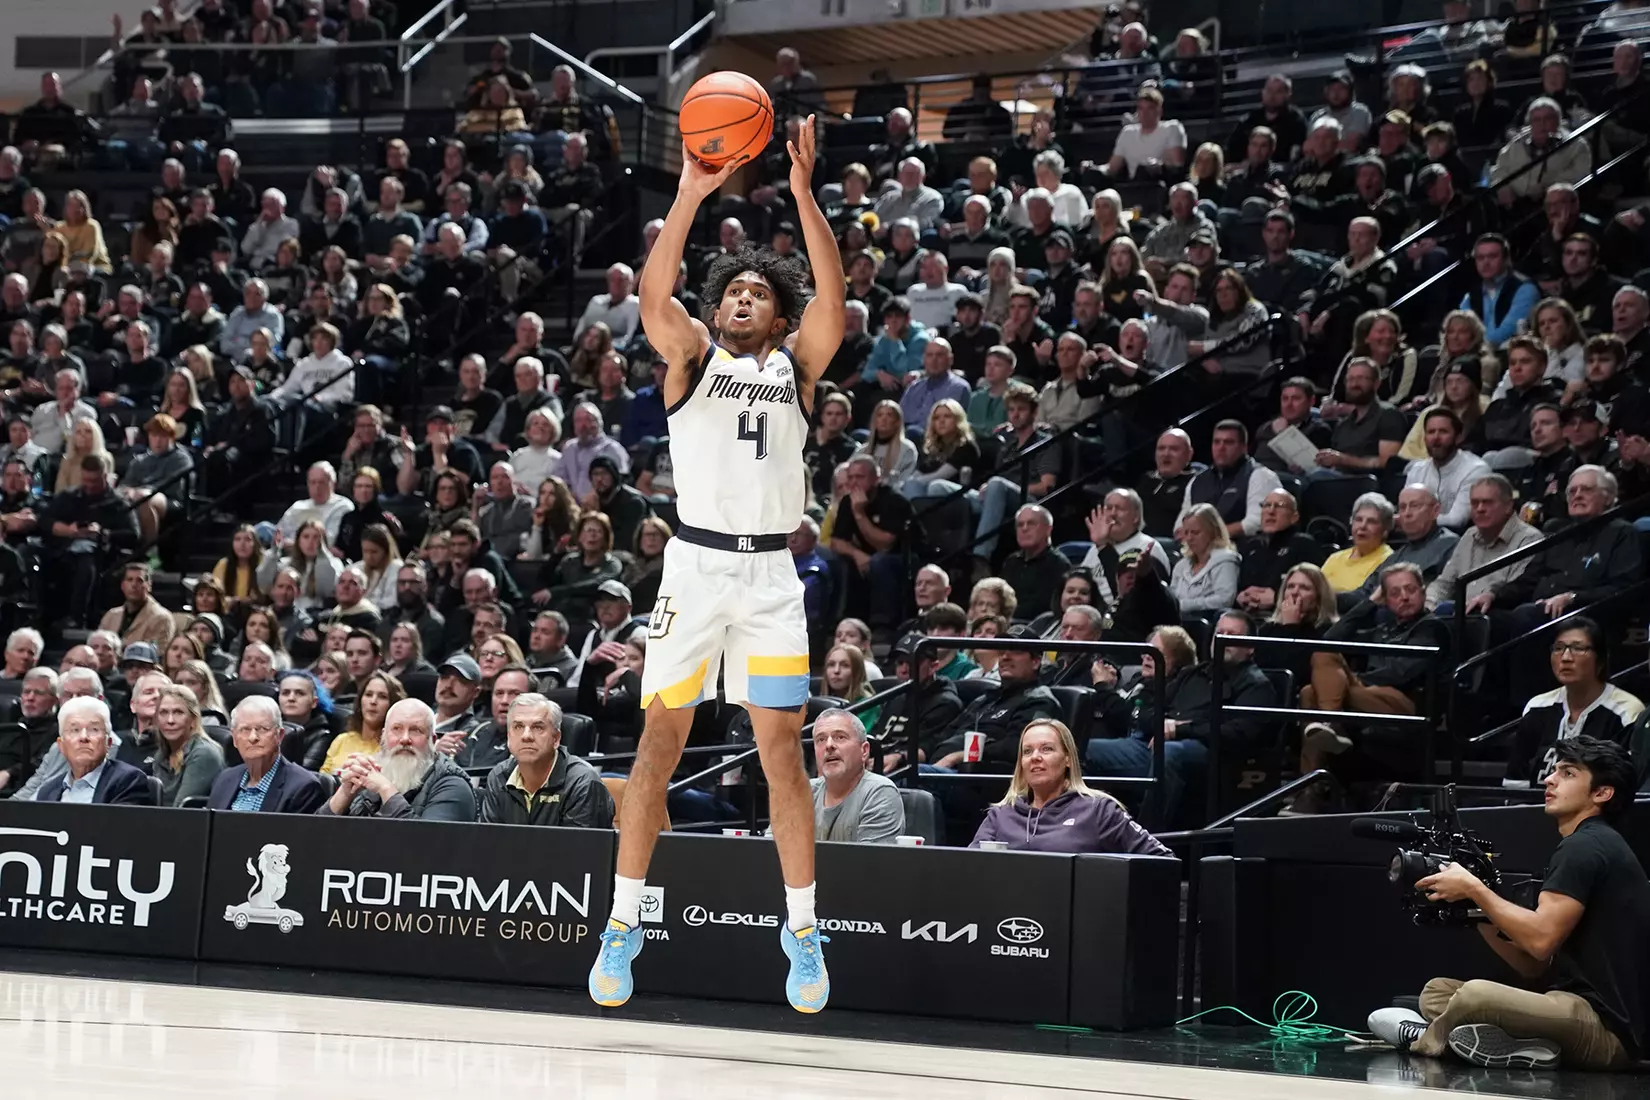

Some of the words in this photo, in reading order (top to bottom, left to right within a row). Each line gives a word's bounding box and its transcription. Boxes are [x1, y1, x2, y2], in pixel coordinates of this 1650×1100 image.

[707, 374, 796, 407] Marquette
[737, 411, 768, 460] 4
[321, 869, 591, 918] ROHRMAN
[328, 909, 486, 938] AUTOMOTIVE
[500, 919, 588, 944] GROUP
[709, 911, 779, 928] LEXUS
[901, 919, 978, 944] KIA
[990, 945, 1050, 958] SUBARU
